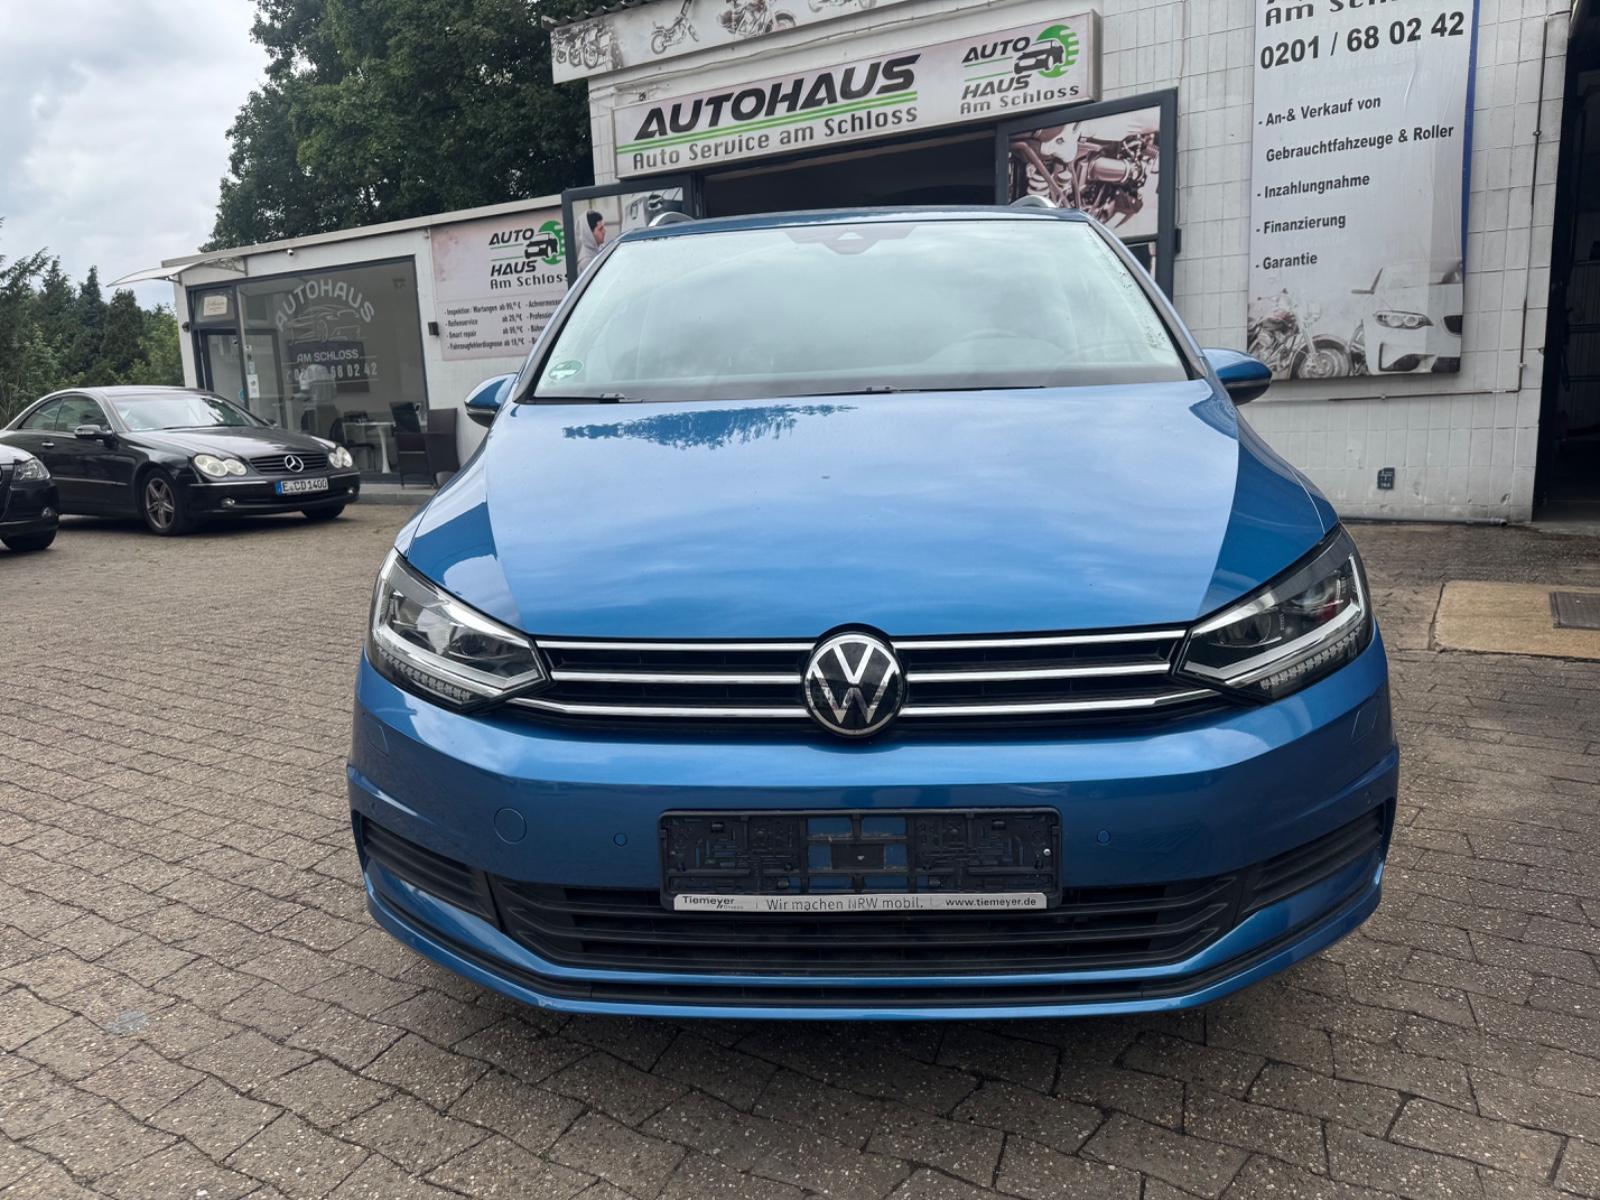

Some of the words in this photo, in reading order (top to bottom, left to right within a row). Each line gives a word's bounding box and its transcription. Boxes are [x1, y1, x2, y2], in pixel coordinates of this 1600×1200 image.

[1265, 3, 1314, 27] Am
[961, 36, 1031, 64] AUTO
[1260, 35, 1320, 70] 0201
[1347, 25, 1379, 52] 68
[1389, 17, 1422, 45] 02
[1431, 11, 1465, 38] 42
[633, 53, 922, 141] AUTOHAUS
[961, 73, 1032, 101] HAUS
[960, 100, 991, 115] Am
[999, 85, 1080, 108] Schloss
[1300, 98, 1354, 120] Verkauf
[1357, 96, 1382, 111] von
[633, 152, 680, 170] Auto
[689, 133, 770, 161] Service
[779, 124, 815, 145] am
[824, 106, 918, 137] Schloss
[1266, 133, 1394, 163] Gebrauchtfahzeuge
[1397, 129, 1408, 143] &
[1413, 124, 1455, 141] Roller
[1264, 174, 1371, 199] Inzahlungnahme
[489, 228, 535, 246] AUTO
[1263, 215, 1347, 235] Finanzierung
[490, 260, 538, 277] HAUS
[1263, 252, 1318, 270] Garantie
[490, 279, 512, 290] Am
[276, 279, 375, 333] AUTOHAUS
[296, 353, 312, 363] AM
[313, 349, 360, 362] SCHLOSS
[682, 895, 736, 909] Tiemeyer
[767, 898, 790, 911] Wir
[792, 898, 844, 911] machen
[882, 896, 924, 910] mobil.
[945, 897, 1037, 908] www.tiemeyer.de
